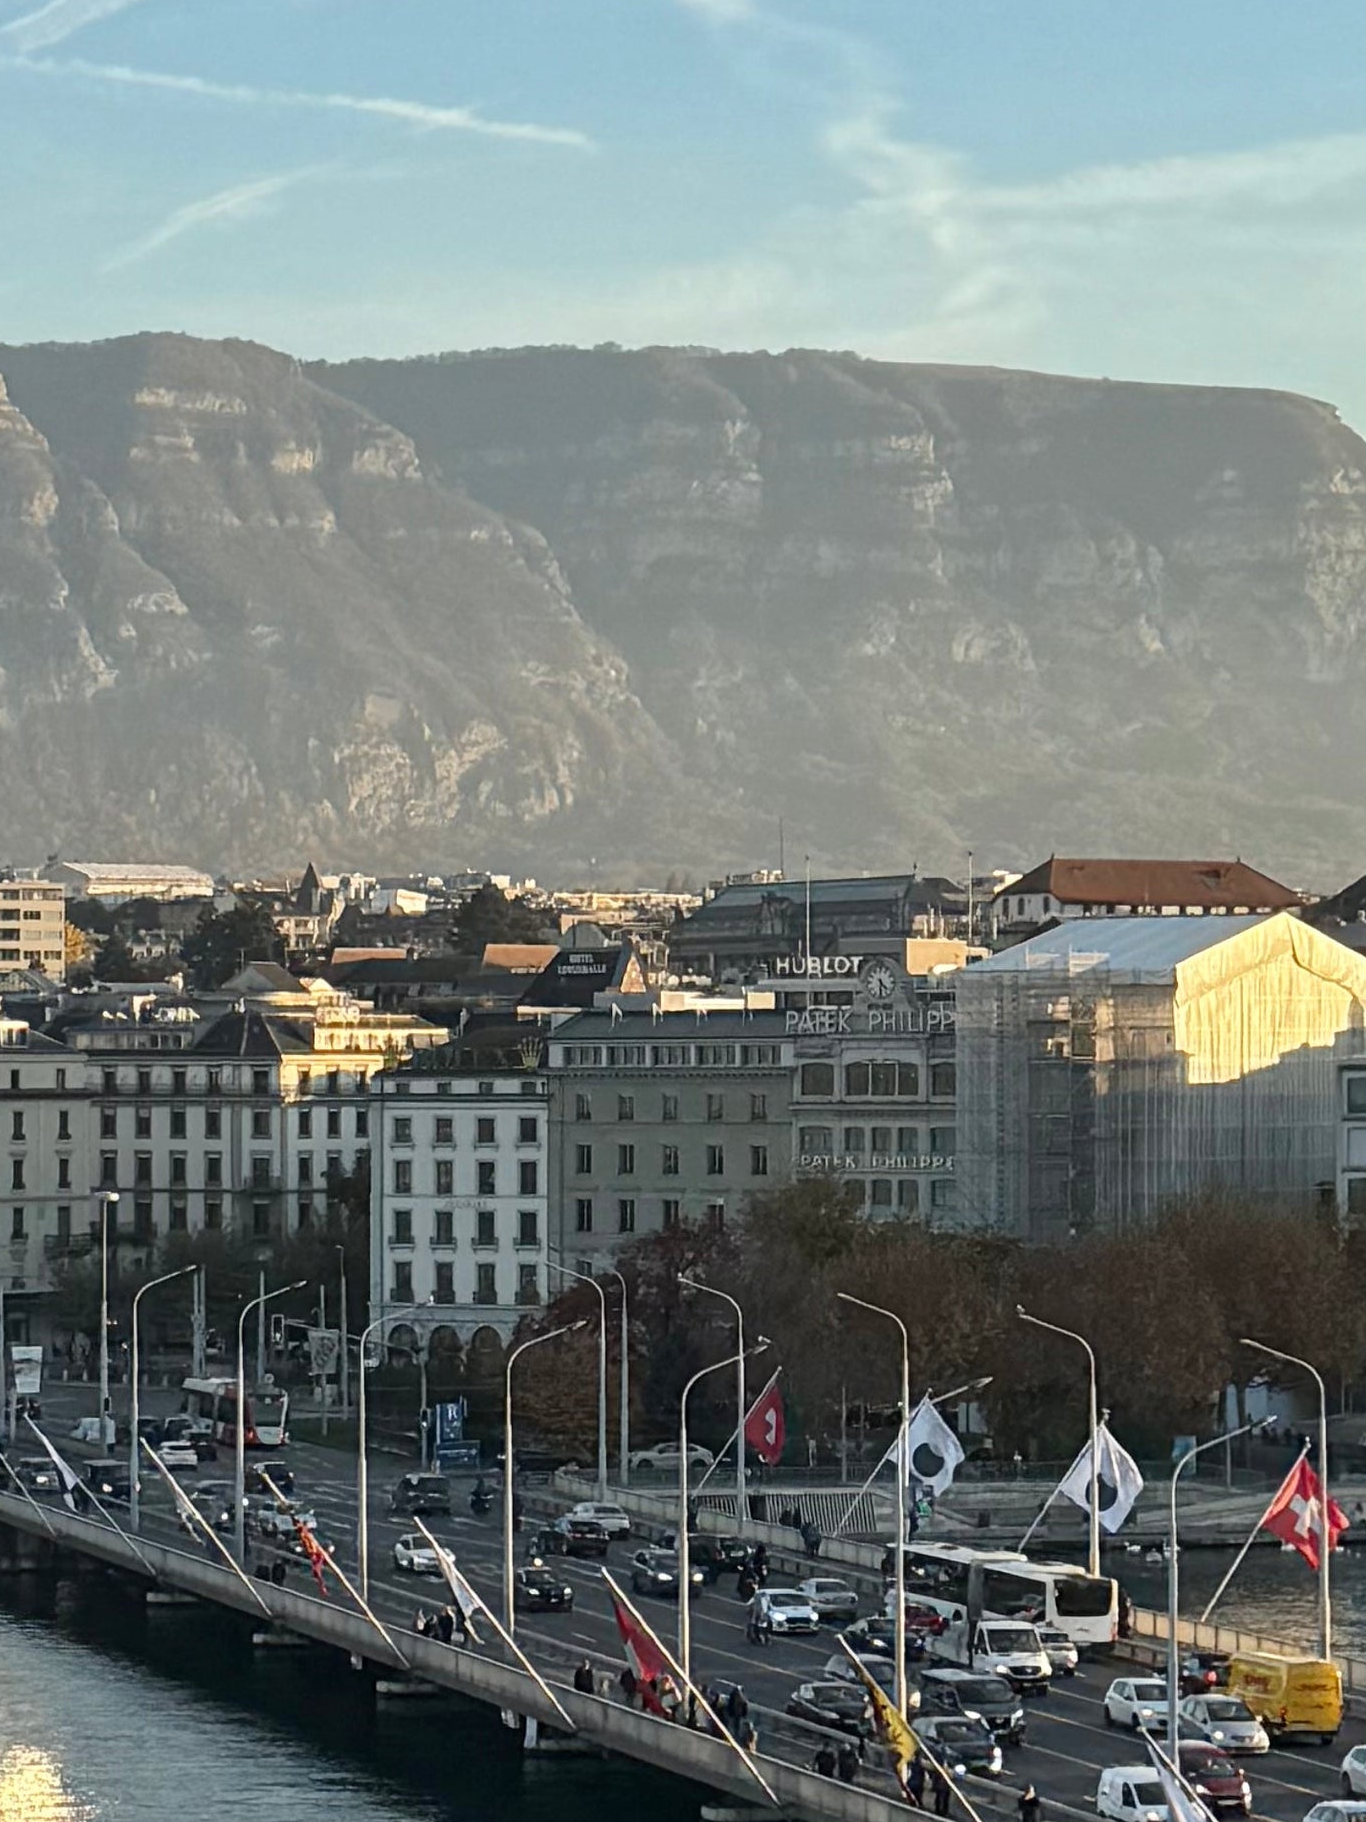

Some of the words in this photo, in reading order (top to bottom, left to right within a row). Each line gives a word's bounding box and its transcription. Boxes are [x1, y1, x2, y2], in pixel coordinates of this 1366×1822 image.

[776, 956, 864, 977] HUBLOT
[785, 1010, 852, 1034] PATEK
[868, 1008, 956, 1033] PHILIPP
[800, 1154, 856, 1169] PATEK
